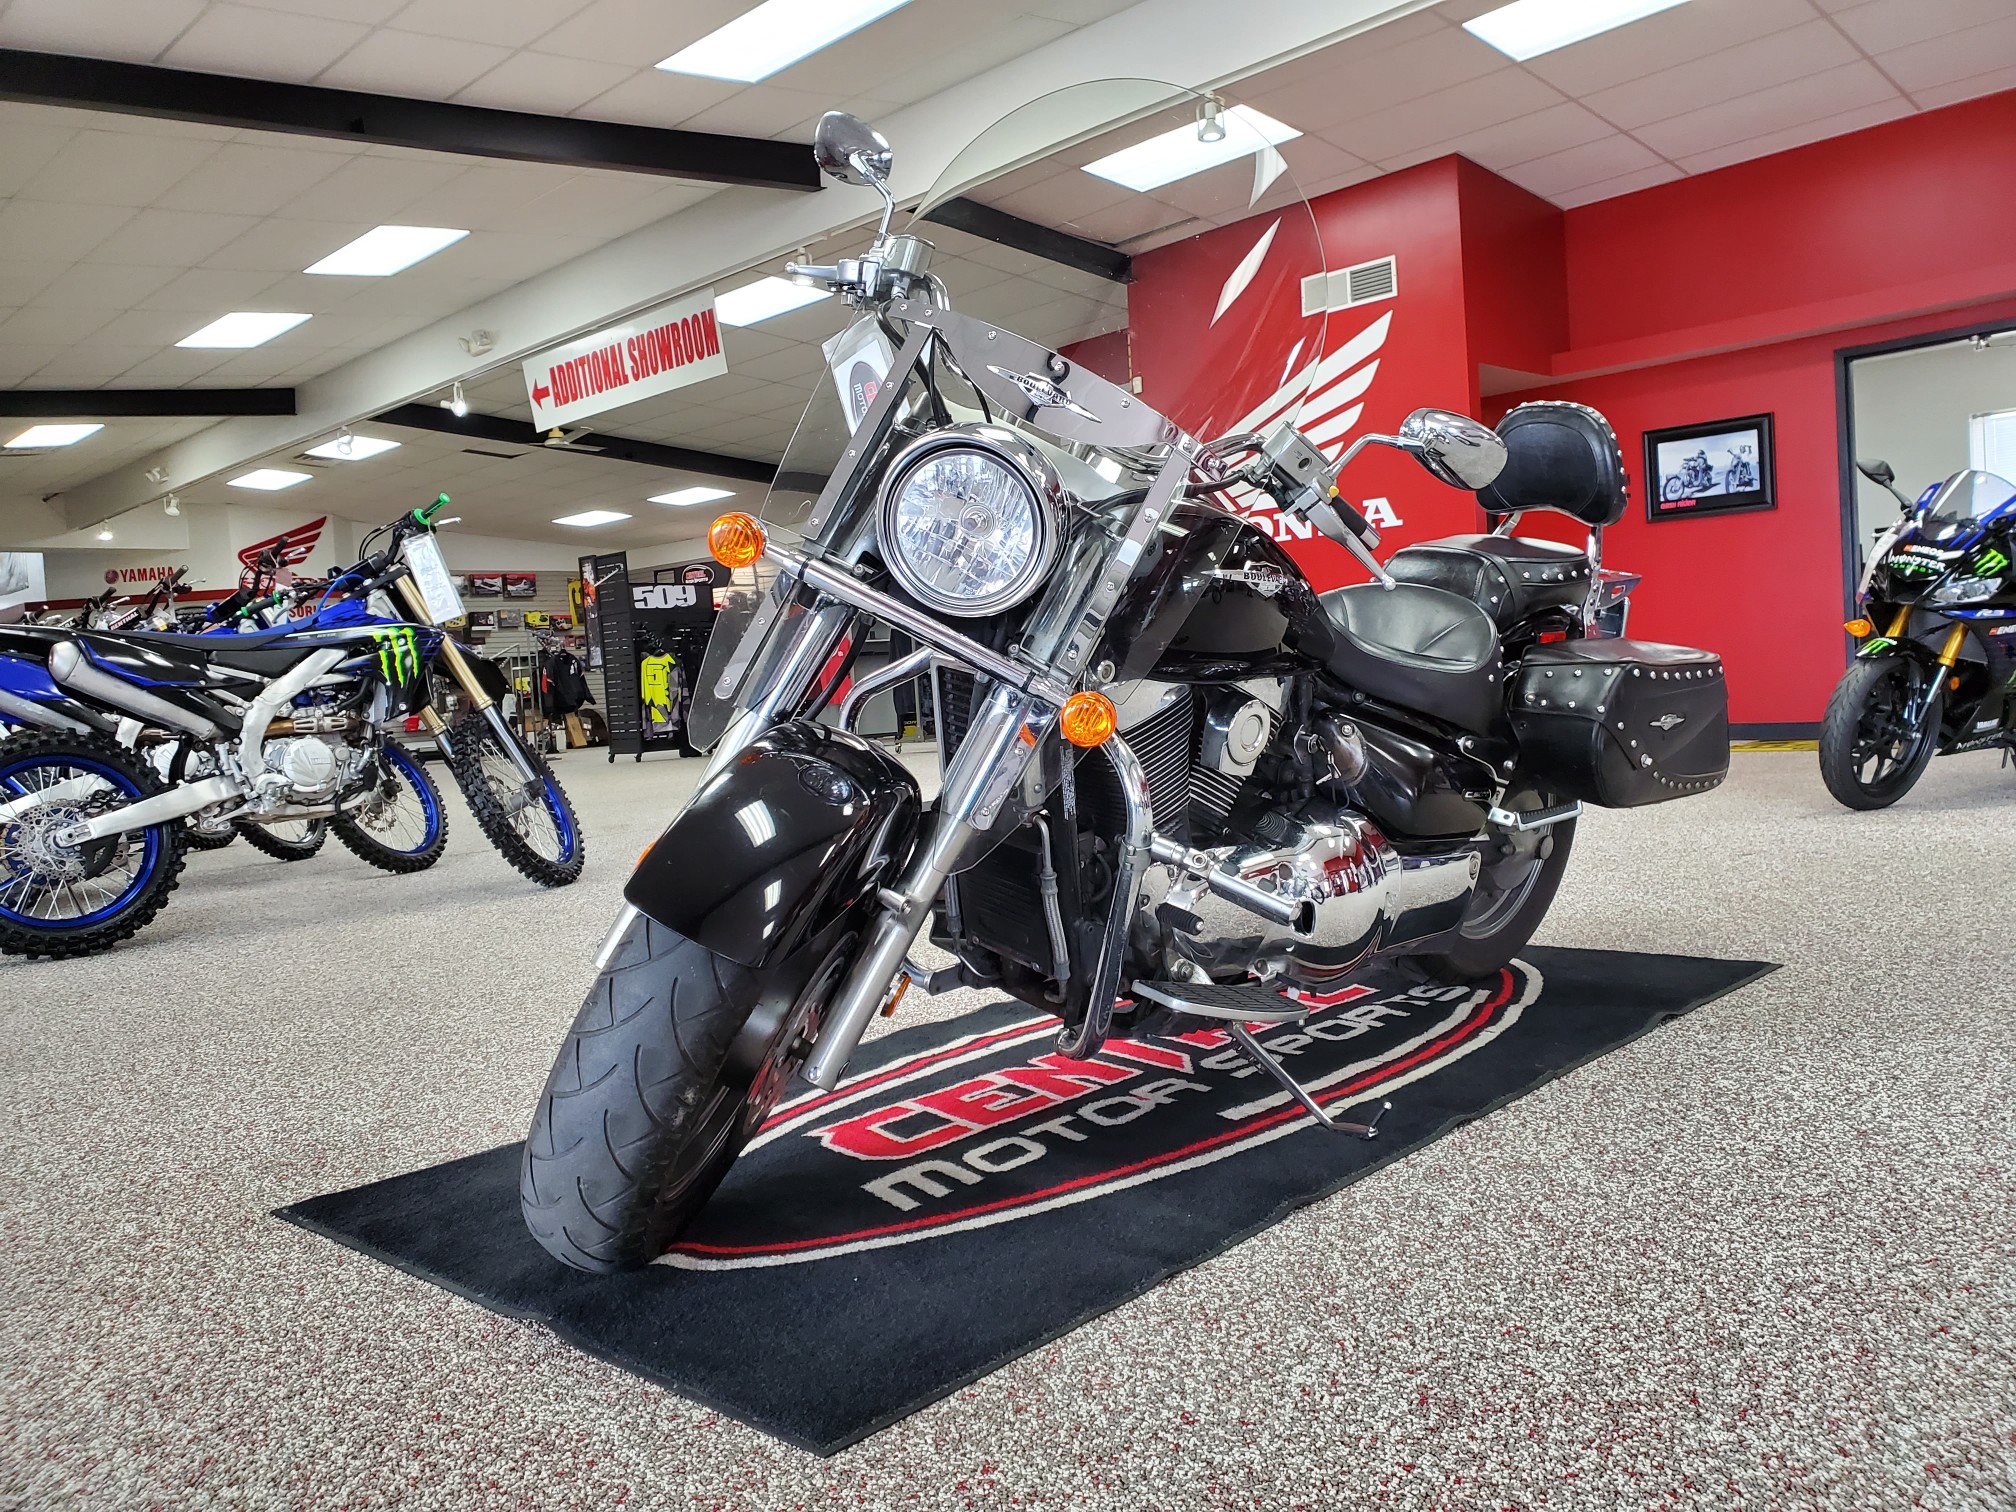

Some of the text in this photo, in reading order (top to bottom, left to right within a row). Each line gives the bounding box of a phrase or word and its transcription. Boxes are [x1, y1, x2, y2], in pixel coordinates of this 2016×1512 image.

[549, 308, 720, 408] ADDITIONAL SHOWROOM
[853, 382, 868, 415] MOTO
[1016, 375, 1071, 405] BOULEVARD
[119, 566, 174, 582] YAMAHA
[1888, 549, 1946, 575] MONSTER
[632, 585, 696, 608] 509
[860, 984, 1471, 1212] MOTOR SPORTS
